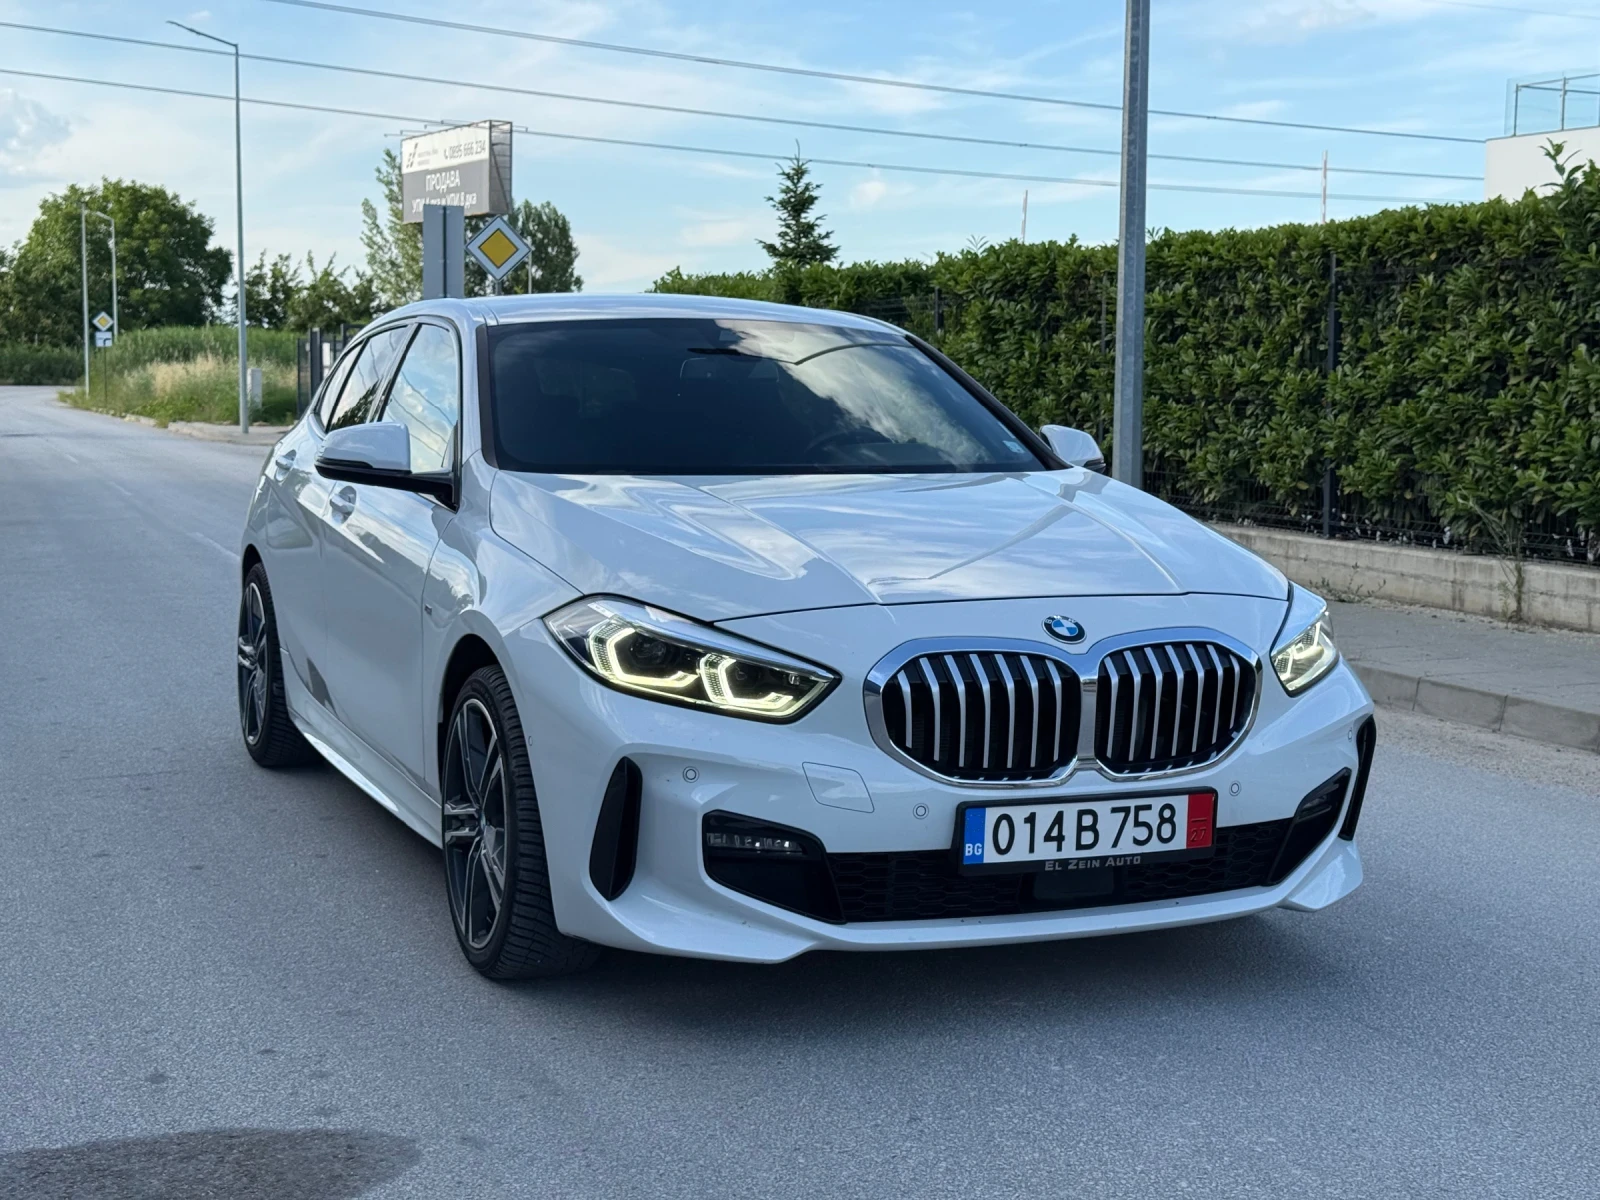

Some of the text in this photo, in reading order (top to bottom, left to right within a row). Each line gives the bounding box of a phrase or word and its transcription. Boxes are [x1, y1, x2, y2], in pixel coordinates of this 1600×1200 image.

[425, 170, 460, 193] ПРОДАВА
[965, 843, 983, 857] BG
[1190, 827, 1207, 842] 27
[1044, 855, 1142, 871] EL ZEIN AUTO
